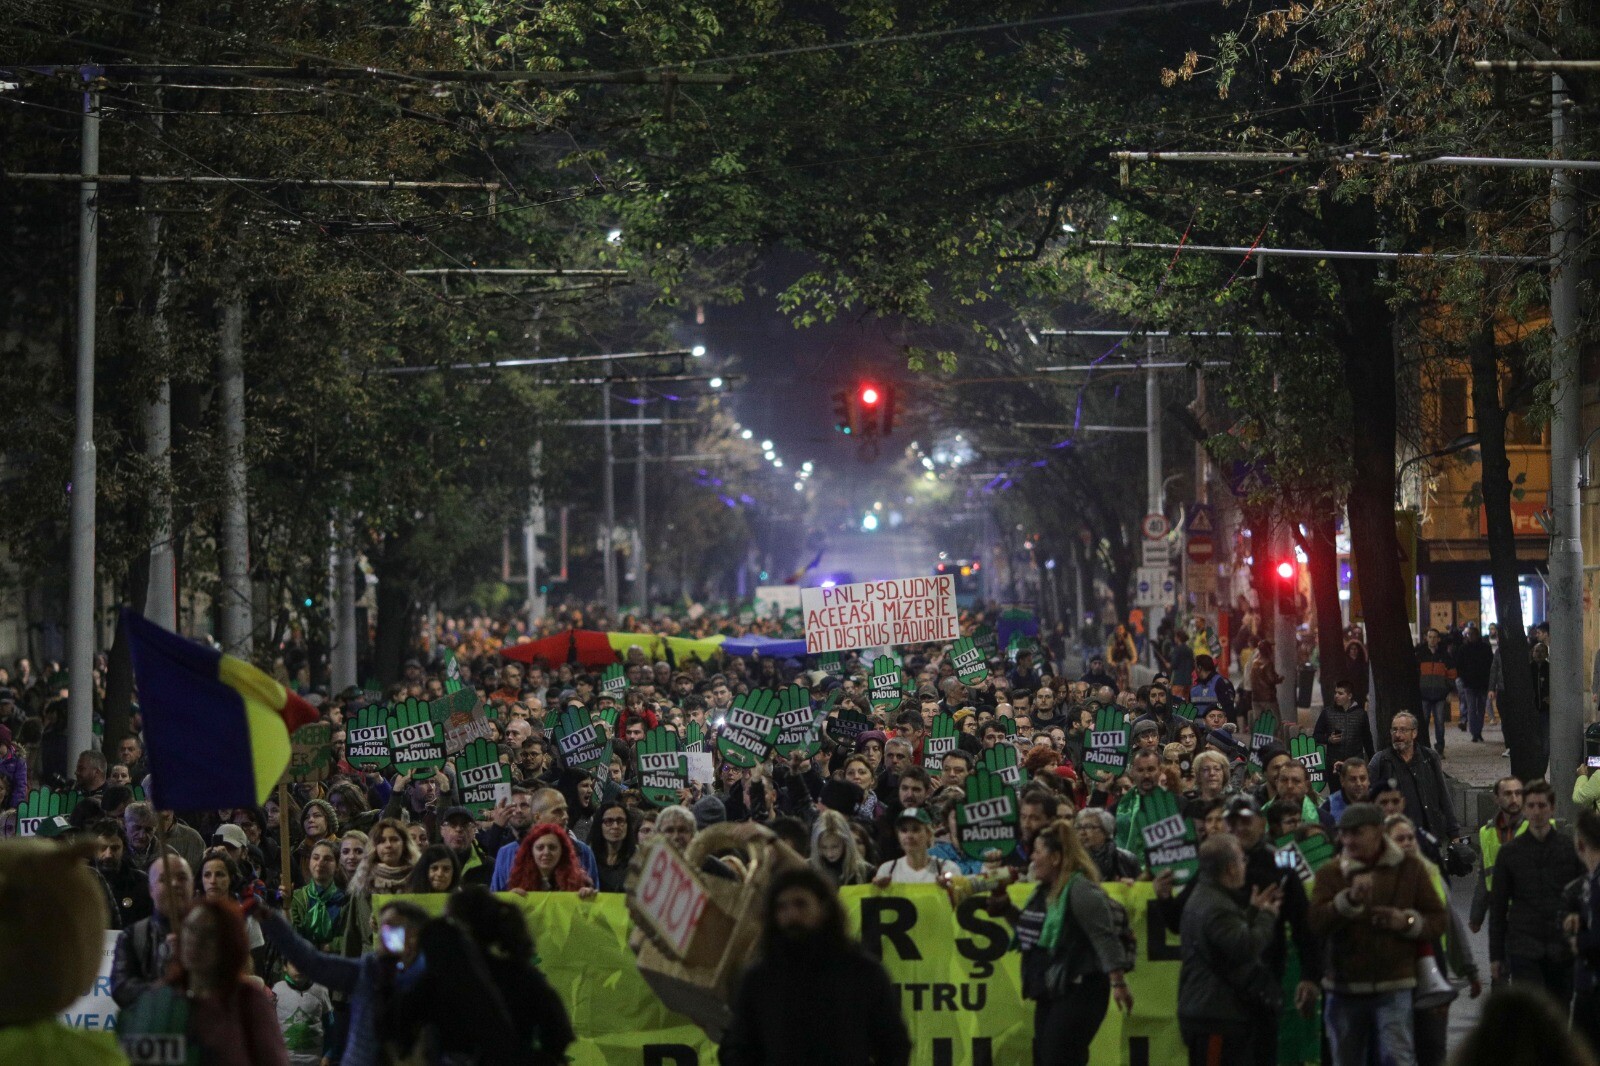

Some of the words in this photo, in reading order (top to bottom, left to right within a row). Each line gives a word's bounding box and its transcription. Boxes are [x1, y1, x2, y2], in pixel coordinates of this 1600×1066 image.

[834, 623, 890, 649] DISTRUS
[396, 748, 442, 763] PĂDURI
[642, 775, 684, 789] PĂDURI
